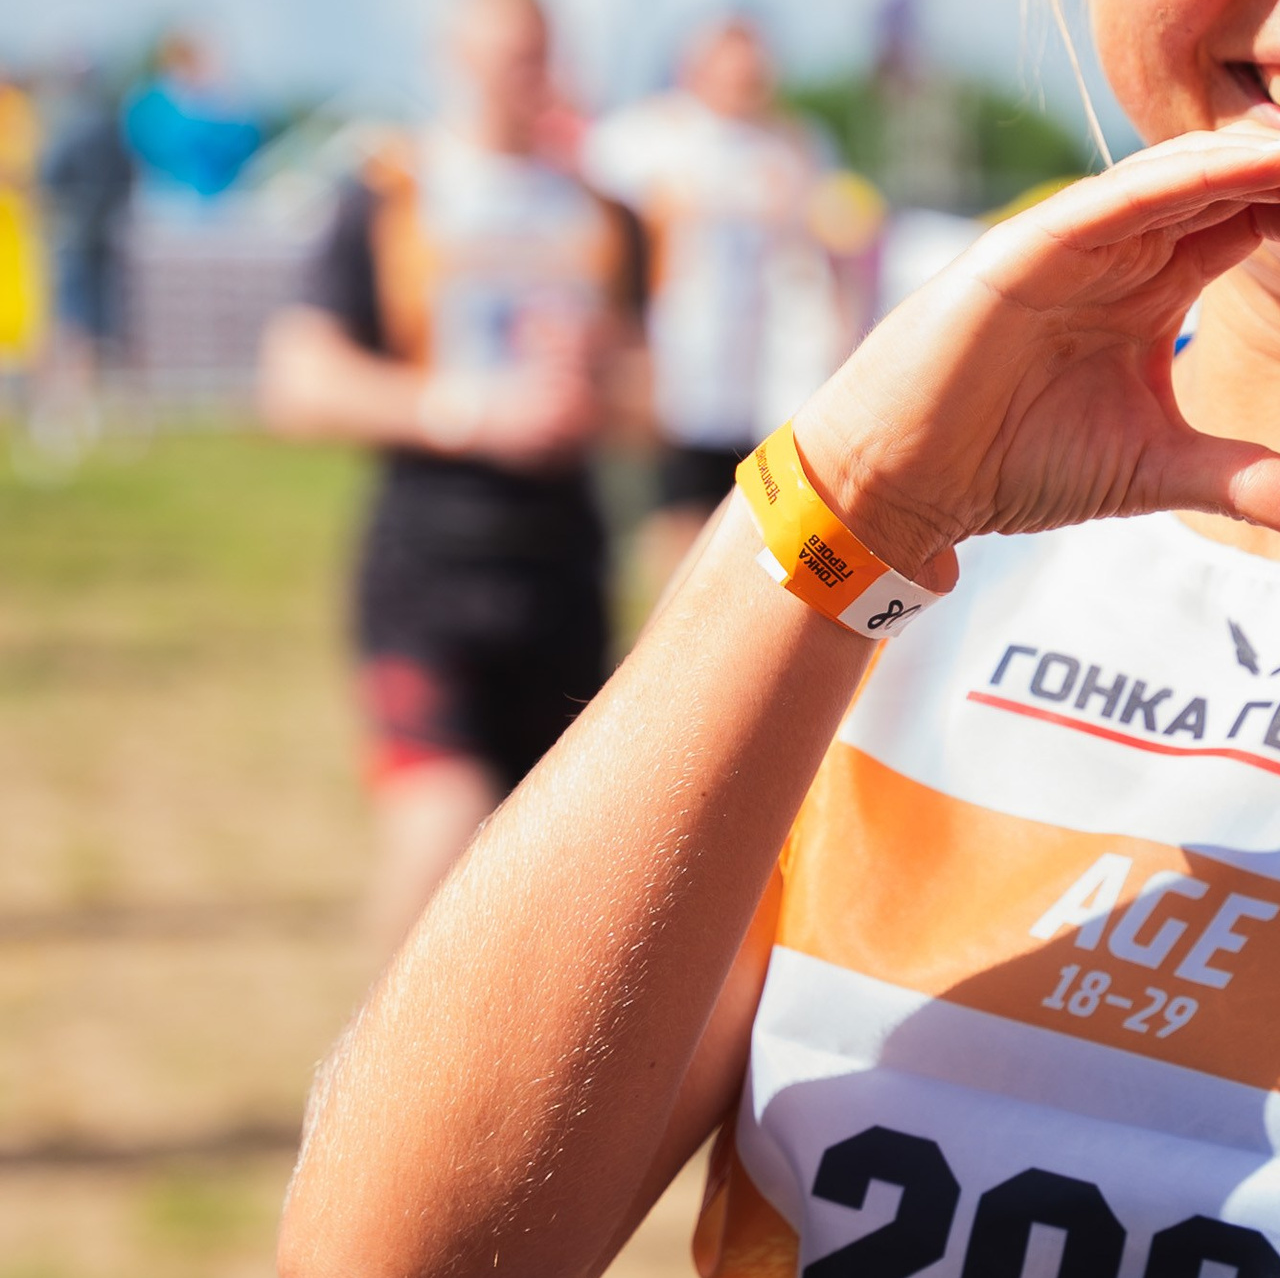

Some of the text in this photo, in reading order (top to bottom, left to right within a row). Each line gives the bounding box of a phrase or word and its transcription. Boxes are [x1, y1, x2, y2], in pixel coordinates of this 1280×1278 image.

[798, 547, 838, 589] ГОНКА
[808, 534, 854, 580] ГЕРОЕВ
[988, 644, 1210, 741] ГОНКА
[1028, 852, 1280, 990] AGE
[1041, 964, 1200, 1040] 18-29
